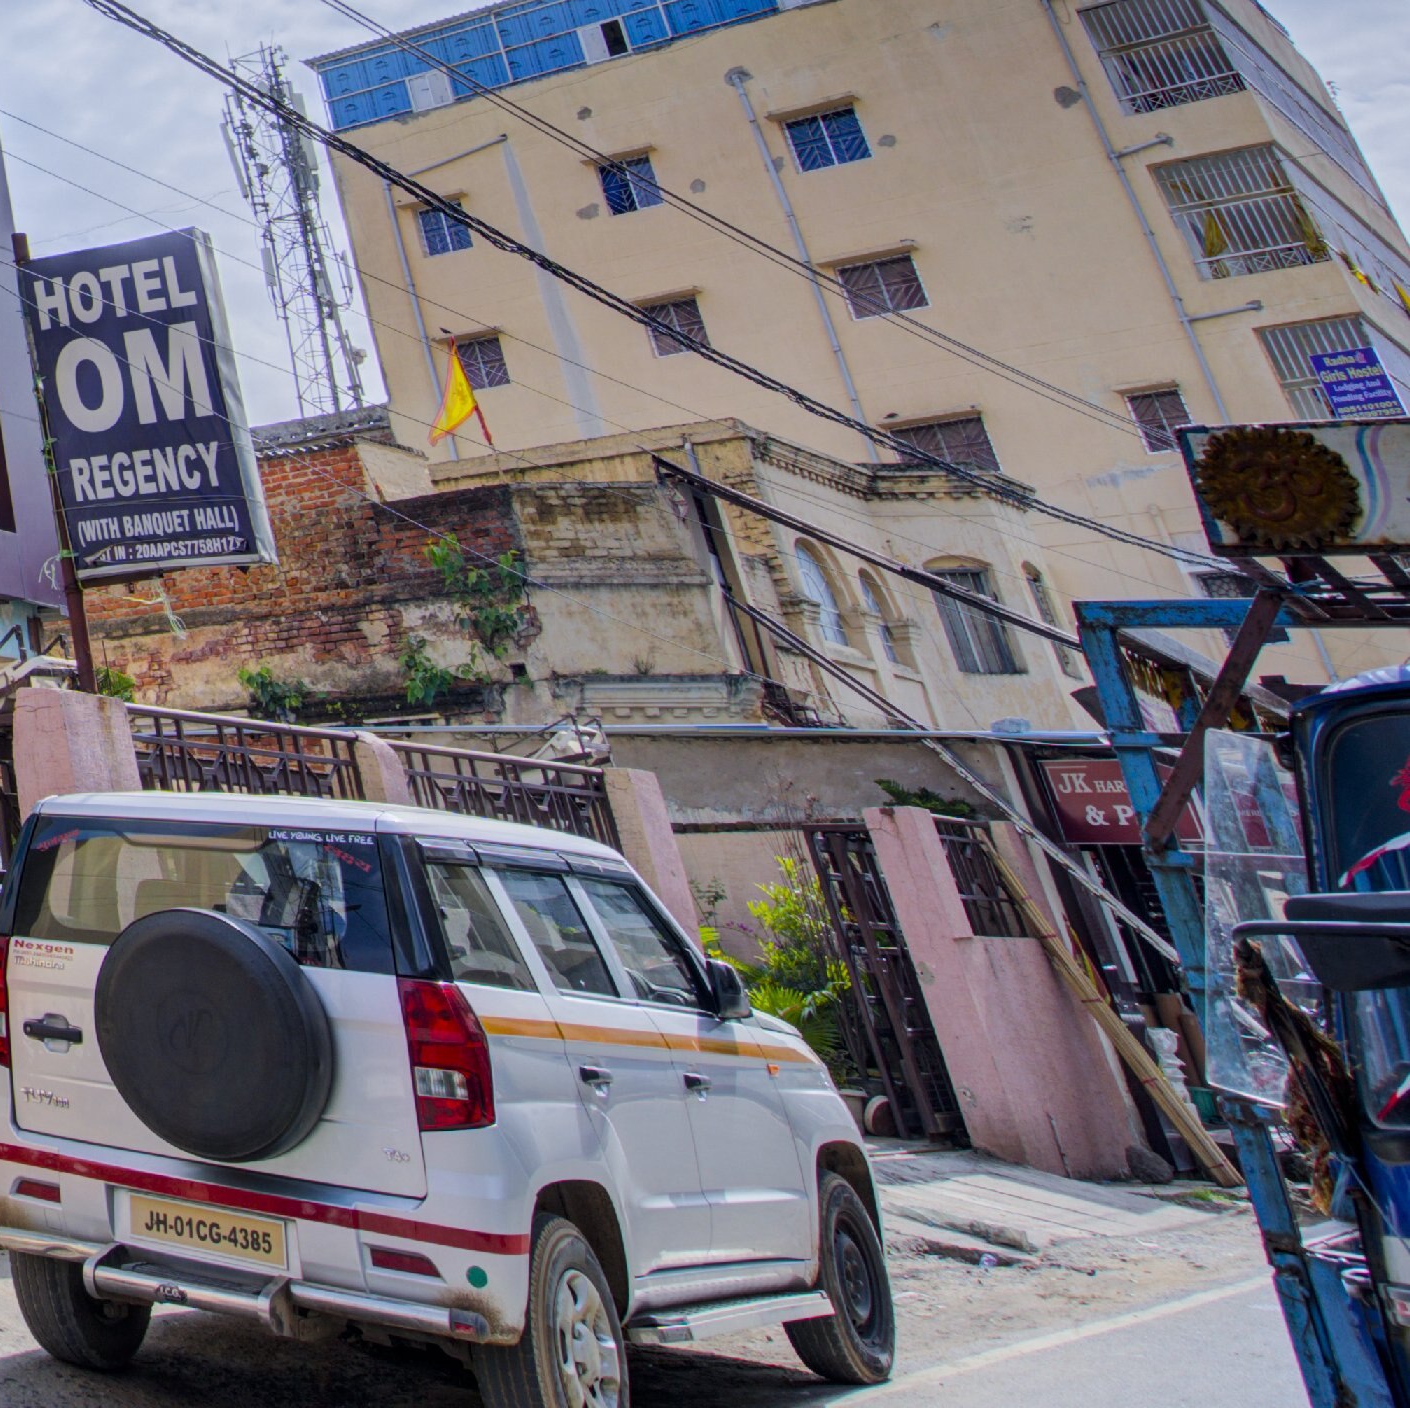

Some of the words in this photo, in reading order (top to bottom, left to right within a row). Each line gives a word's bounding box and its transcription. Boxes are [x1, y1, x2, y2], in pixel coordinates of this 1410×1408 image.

[32, 254, 198, 332] HOTEL
[1323, 354, 1356, 367] Radha
[54, 319, 216, 434] OM
[1320, 369, 1348, 383] Girls
[1346, 362, 1384, 379] Hostel
[68, 440, 221, 503] REGENCY
[122, 509, 191, 537] BANQUET
[193, 505, 240, 532] HALL)
[1057, 772, 1093, 794] JK
[1085, 804, 1110, 826] &
[268, 830, 288, 840] LIVE
[325, 834, 347, 843] LIVE
[348, 834, 375, 845] FREE
[14, 939, 75, 955] Nexgen
[143, 1209, 273, 1255] JH-01CG-4385
